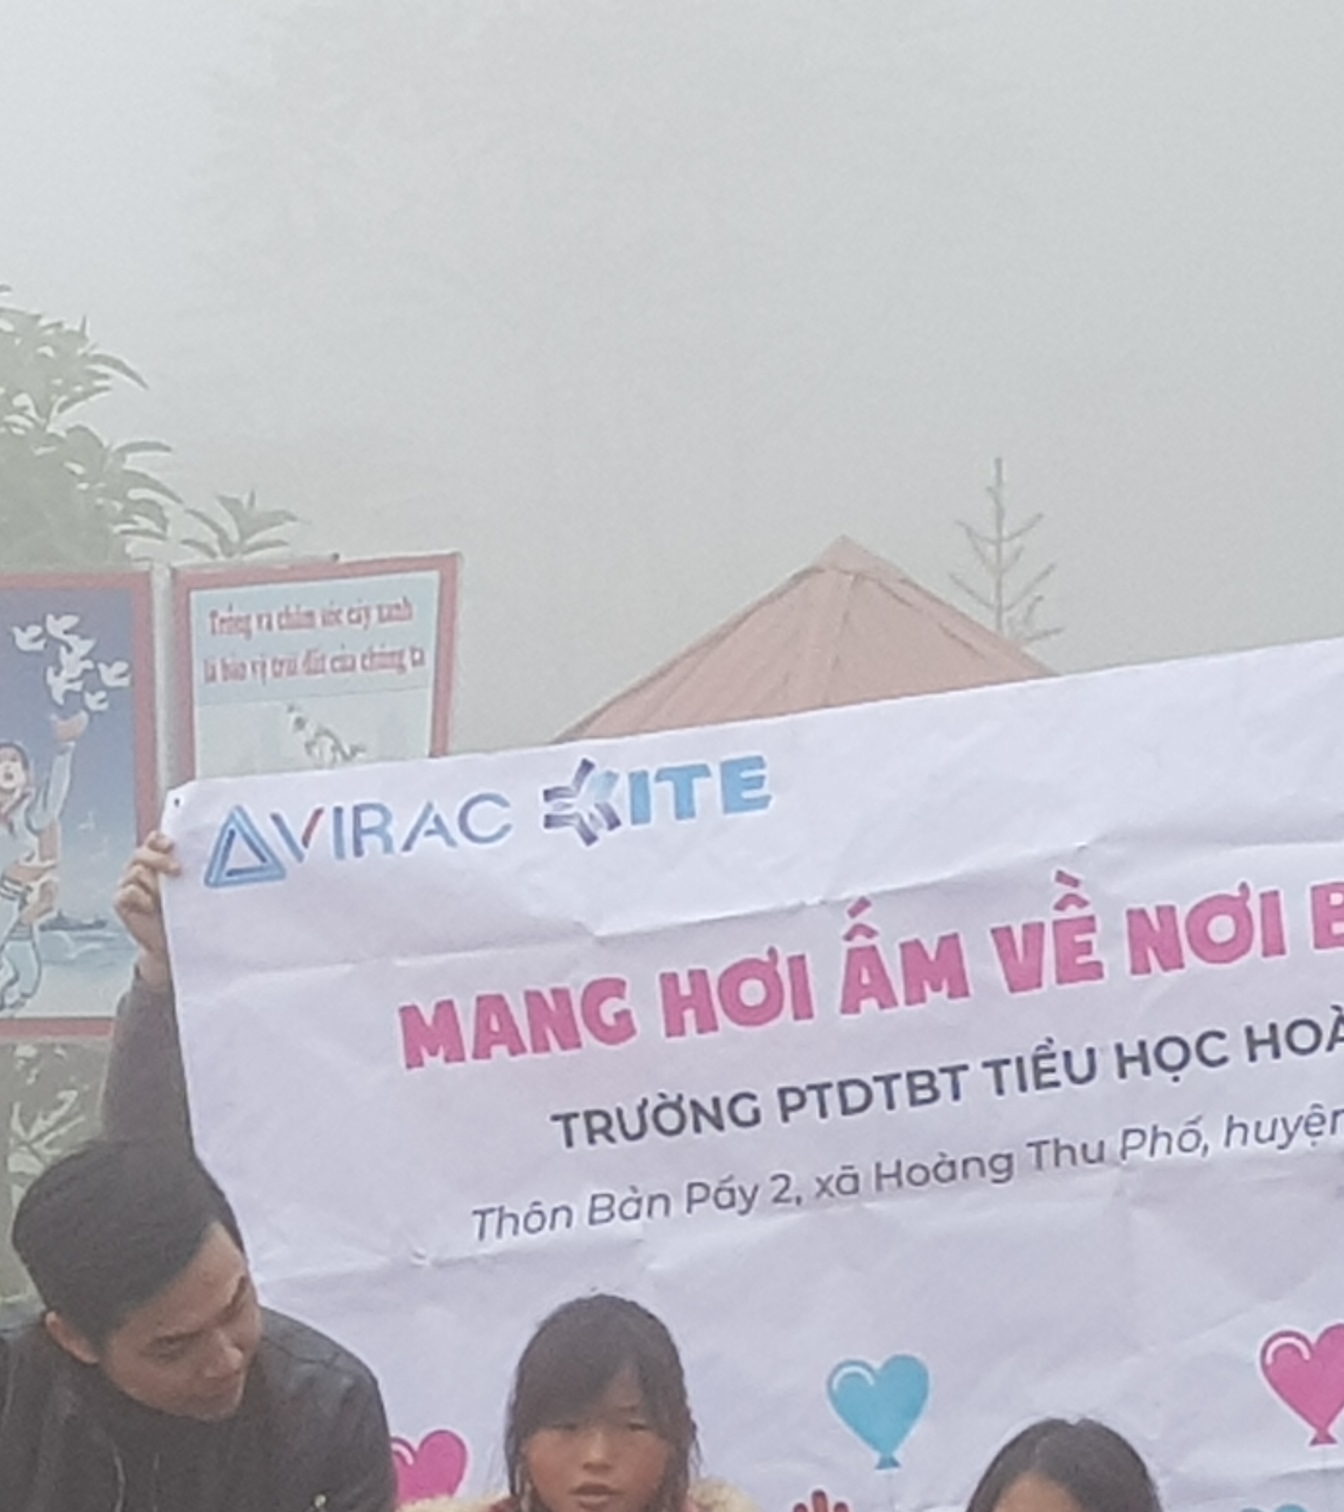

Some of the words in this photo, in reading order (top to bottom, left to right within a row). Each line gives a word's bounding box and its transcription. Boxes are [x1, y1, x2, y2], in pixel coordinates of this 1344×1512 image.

[270, 792, 513, 863] VIRAC
[398, 976, 637, 1070] MANG
[659, 946, 814, 1038] HƠI
[840, 895, 971, 1015] ẤM
[990, 869, 1105, 994] VỀ
[1126, 881, 1287, 976] NƠI
[550, 1092, 762, 1149] TRƯỜNG
[776, 1063, 969, 1124] PTDTBT
[981, 1036, 1098, 1097] TIỂU
[1114, 1029, 1230, 1084] HỌC
[471, 1200, 574, 1243] Thôn
[769, 1172, 803, 1207] 2,
[814, 1166, 861, 1198] xã
[874, 1150, 1015, 1193] Hoàng
[1027, 1137, 1106, 1172] Thu
[1118, 1114, 1210, 1162] Phố,
